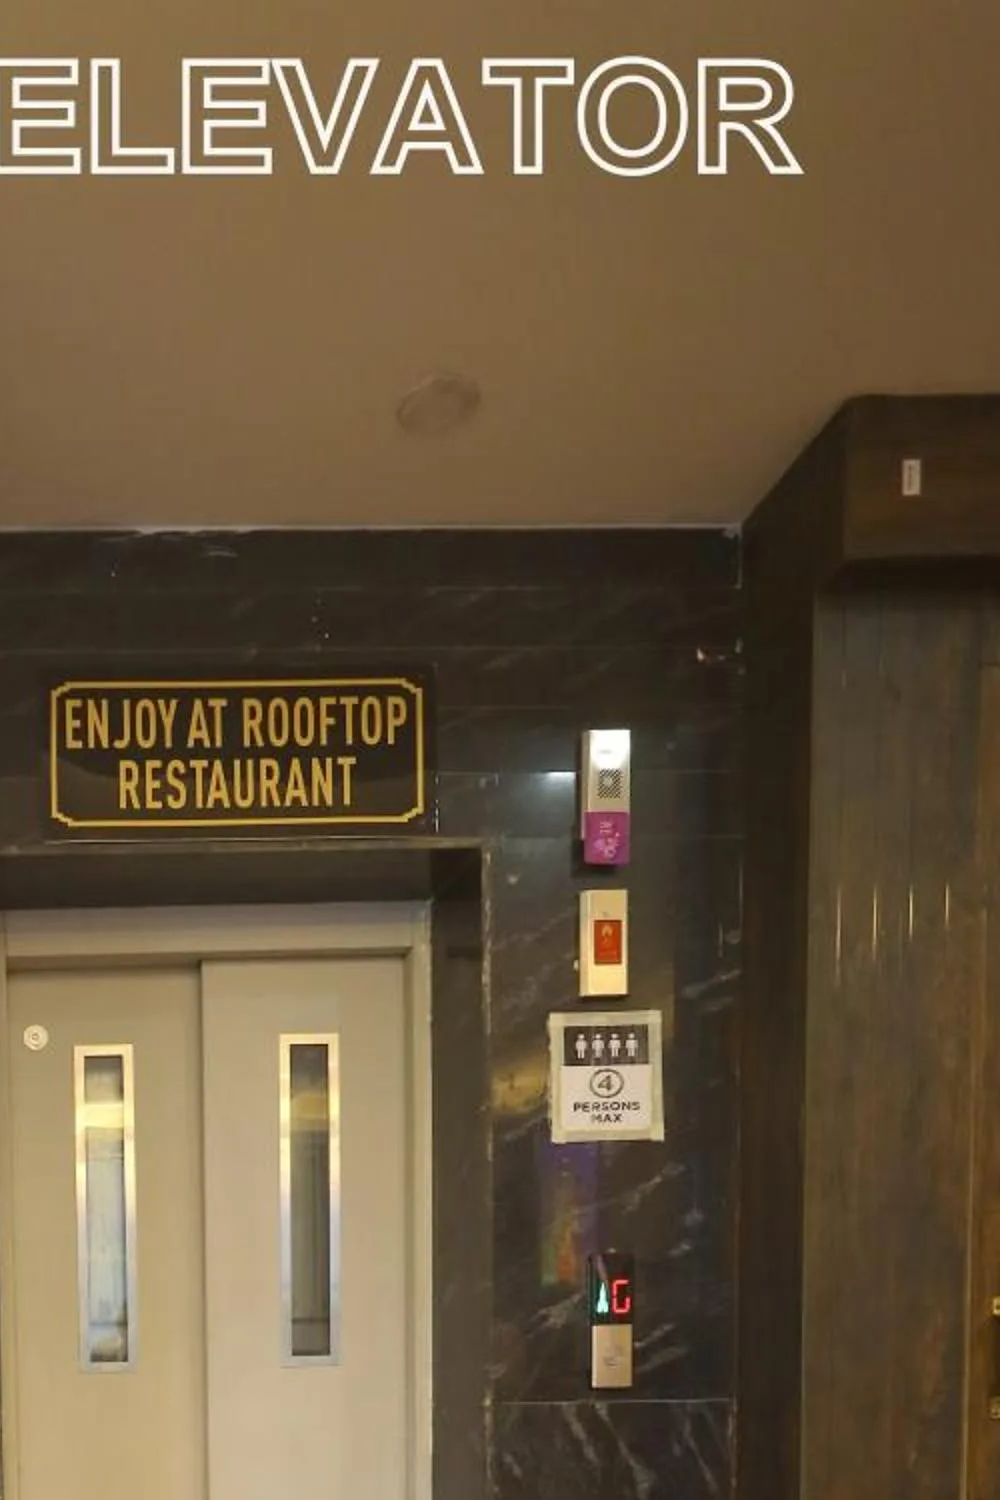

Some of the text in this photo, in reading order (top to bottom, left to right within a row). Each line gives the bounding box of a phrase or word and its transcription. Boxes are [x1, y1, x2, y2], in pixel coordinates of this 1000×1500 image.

[64, 696, 408, 750] ENJOY AT ROOFTOP
[118, 756, 357, 810] RESTAURANT
[572, 1101, 641, 1113] PERSONS
[590, 1113, 624, 1124] MAX
